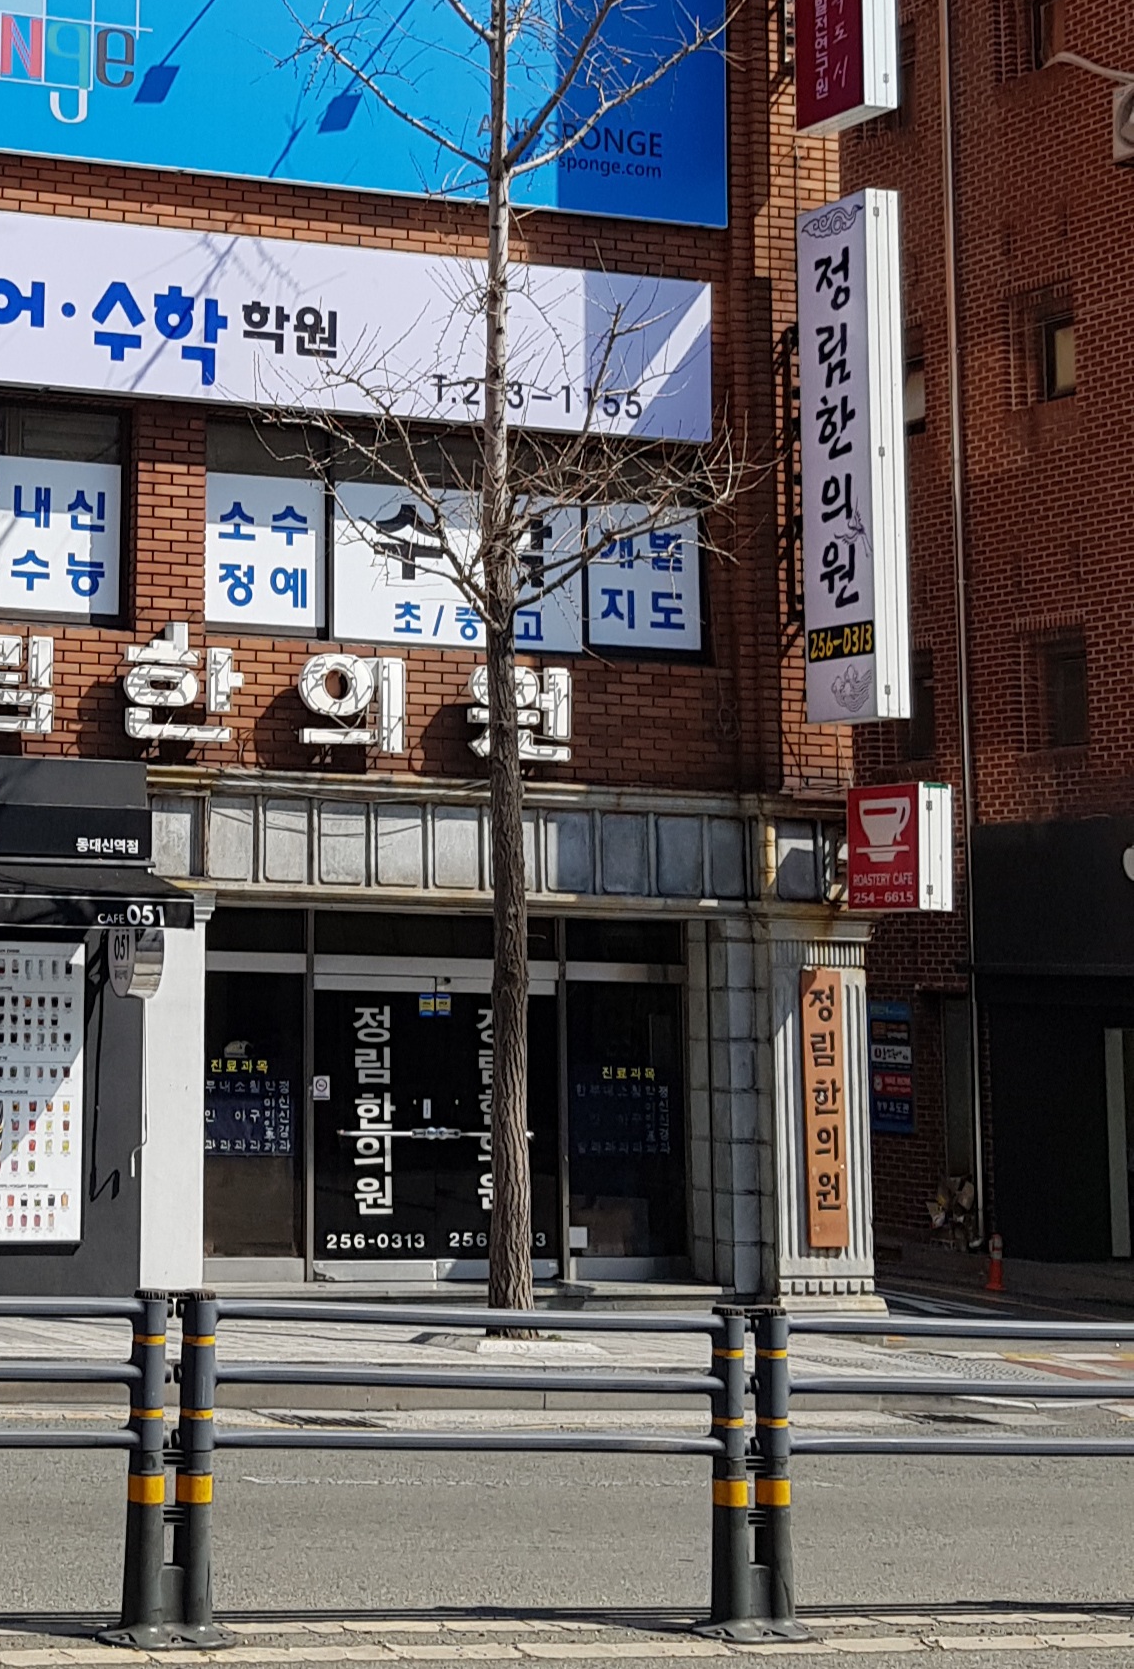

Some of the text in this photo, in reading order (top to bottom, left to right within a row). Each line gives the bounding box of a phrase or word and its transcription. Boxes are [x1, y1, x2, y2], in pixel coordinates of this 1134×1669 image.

[242, 302, 337, 359] 학원
[433, 373, 642, 419] T.23-1155
[814, 246, 860, 608] 정림한의원
[14, 484, 107, 534] 내신
[218, 501, 308, 546] 소수
[11, 549, 106, 597] 수능
[218, 563, 308, 609] 정예
[601, 587, 685, 631] 지도
[809, 624, 873, 660] 256-0313
[76, 837, 139, 855] 동대신역점
[852, 871, 913, 887] ROASTERY CAFE
[853, 891, 914, 904] 254-6615
[97, 904, 165, 927] CAFE 051
[114, 934, 130, 961] 051
[210, 1058, 269, 1074] 진료과목
[353, 1005, 395, 1216] 정림한의원
[809, 985, 841, 1211] 정림한의원
[326, 1233, 426, 1249] 256-0313
